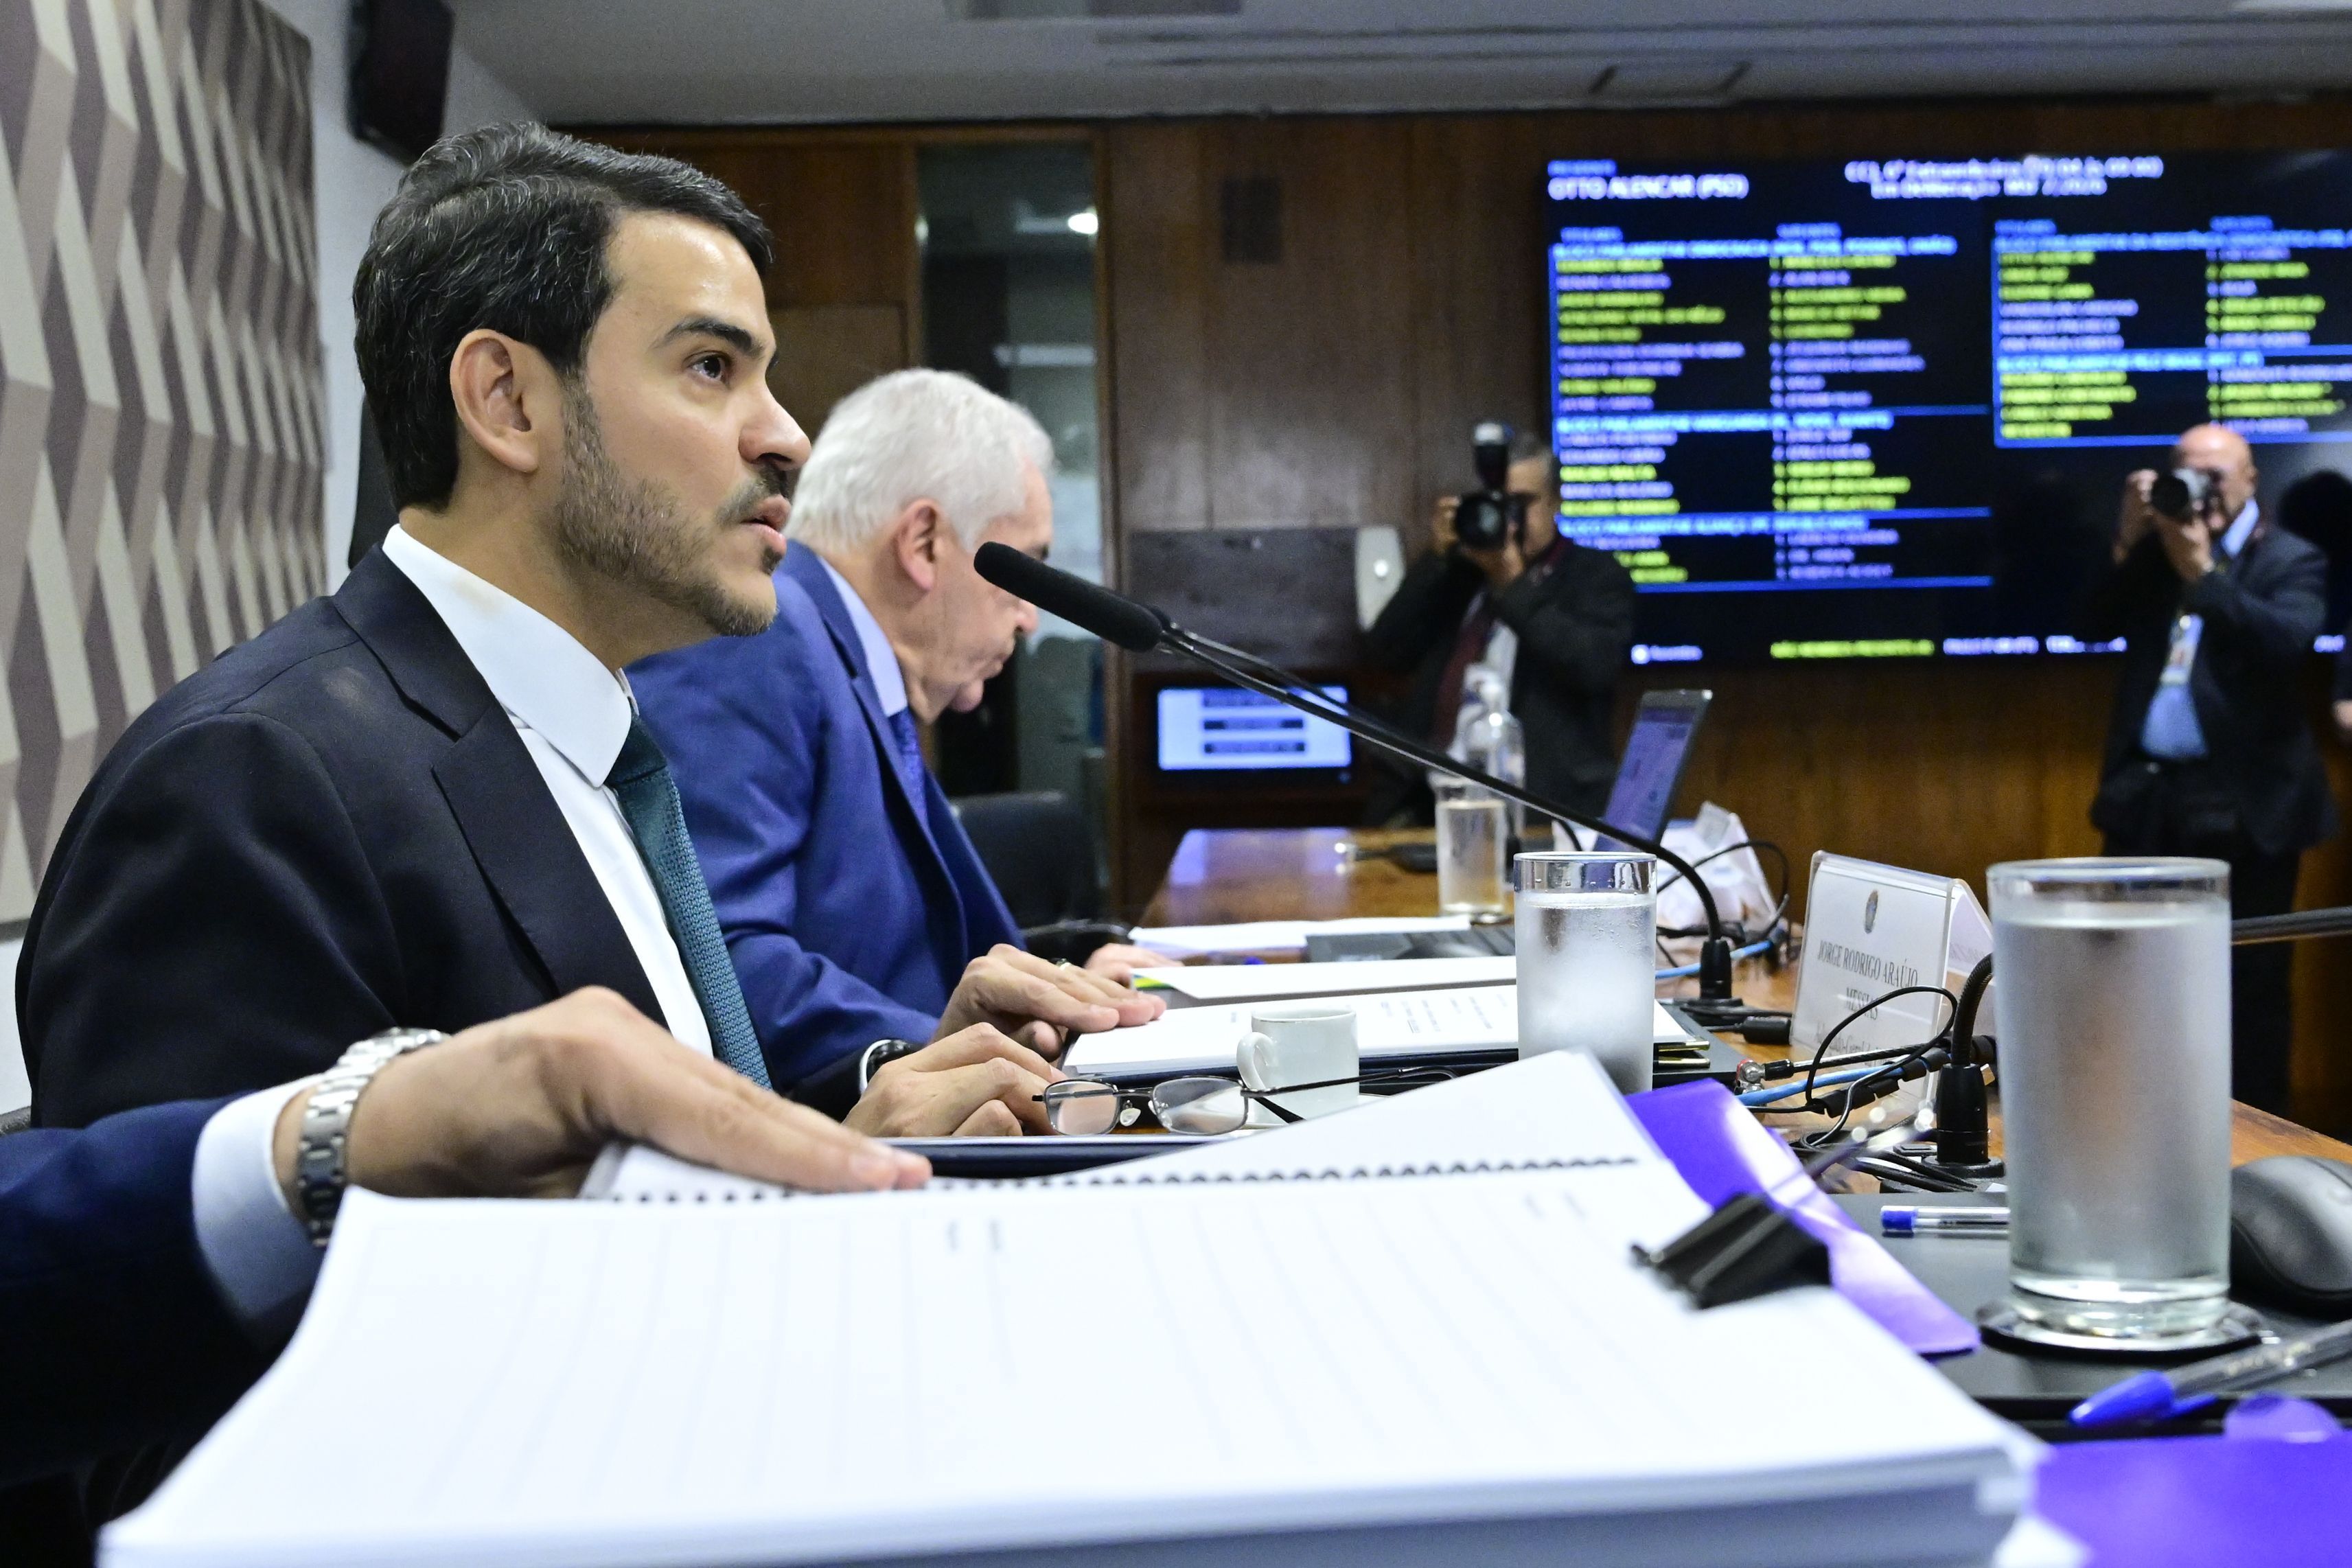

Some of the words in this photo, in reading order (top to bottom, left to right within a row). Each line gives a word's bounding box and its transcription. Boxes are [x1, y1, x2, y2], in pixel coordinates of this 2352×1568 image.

[1817, 940, 1843, 967] JORGE
[1843, 947, 1881, 980] RODRIGO
[1882, 958, 1918, 988] ARAÚJO
